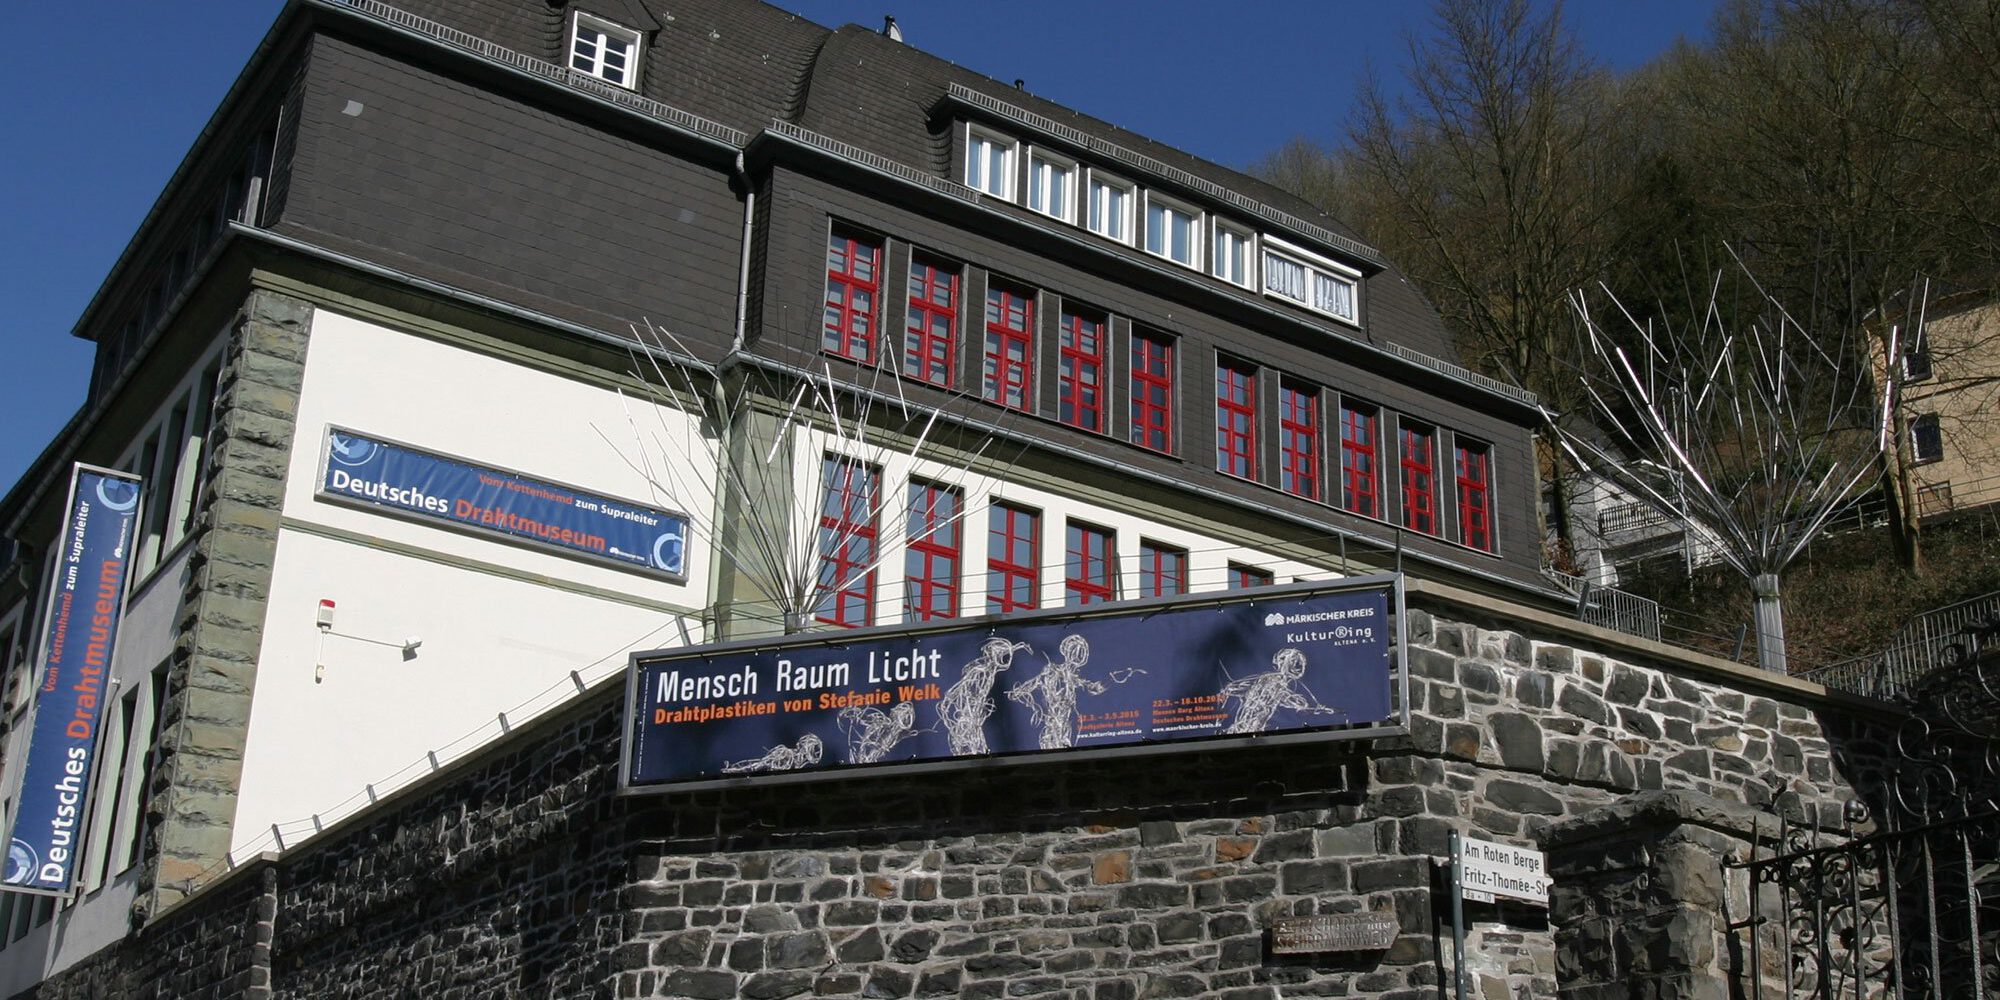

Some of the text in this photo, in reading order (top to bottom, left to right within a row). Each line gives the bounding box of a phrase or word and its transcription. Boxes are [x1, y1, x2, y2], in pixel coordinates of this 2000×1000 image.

[332, 469, 606, 551] Deutsches Drahtmuseum
[479, 475, 658, 527] Vom Kettenhemd zum Supraleiter
[43, 501, 90, 691] Vom Kettenhemd zum Supraleiter
[1286, 608, 1374, 624] MÄRKISCHER KREIS
[656, 648, 941, 704] Mensch Raum Licht
[40, 559, 122, 883] Deutsches Drahtmuseum
[655, 684, 941, 724] Drahtplastiken von Stefanie Welk
[1465, 842, 1540, 872] Am Roten Berge
